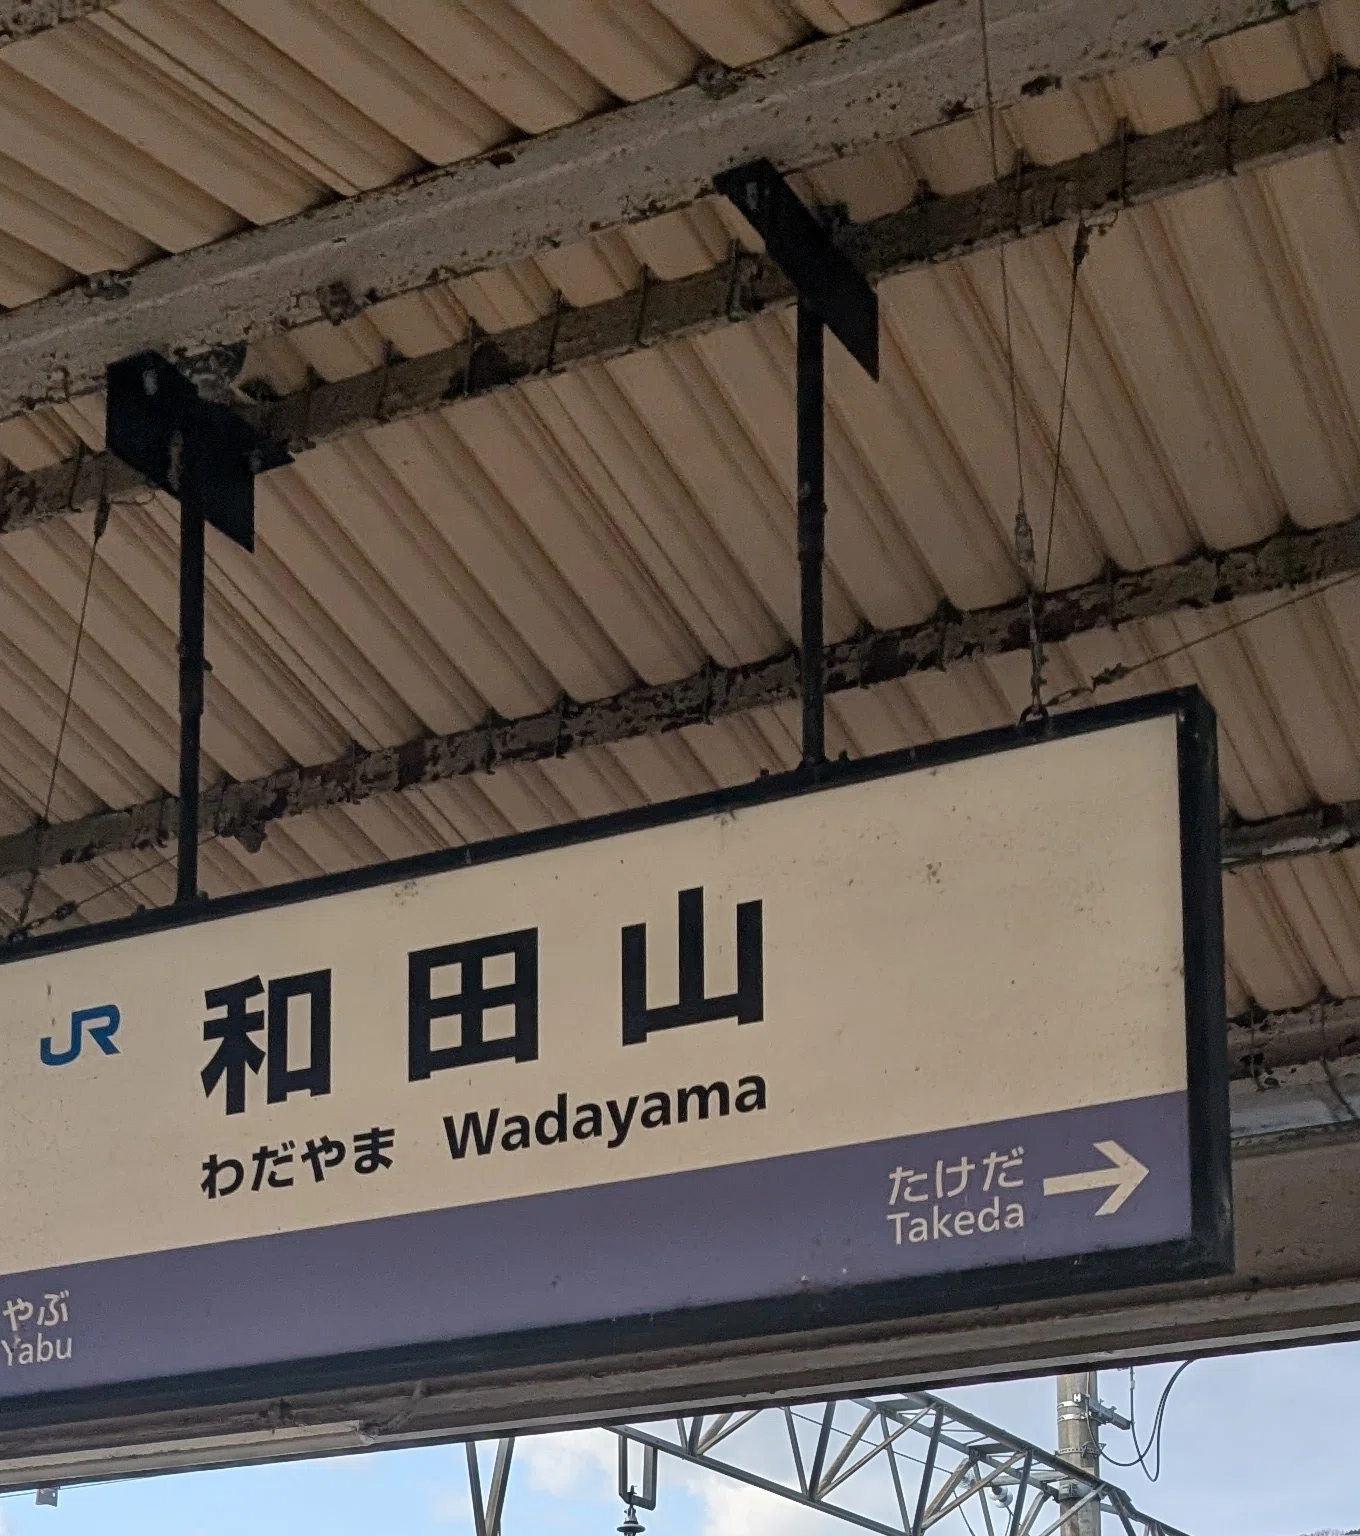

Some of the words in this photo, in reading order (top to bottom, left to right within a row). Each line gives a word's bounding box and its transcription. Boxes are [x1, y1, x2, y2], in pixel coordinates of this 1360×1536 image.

[200, 886, 765, 1114] 和田山
[40, 1004, 121, 1066] JR
[200, 1126, 395, 1200] わだやま
[443, 1074, 767, 1160] Wadayama
[889, 1146, 1024, 1206] たけだ
[887, 1196, 1024, 1245] Takeda
[2, 1290, 70, 1331] やぶ
[1, 1333, 72, 1366] Yabu
